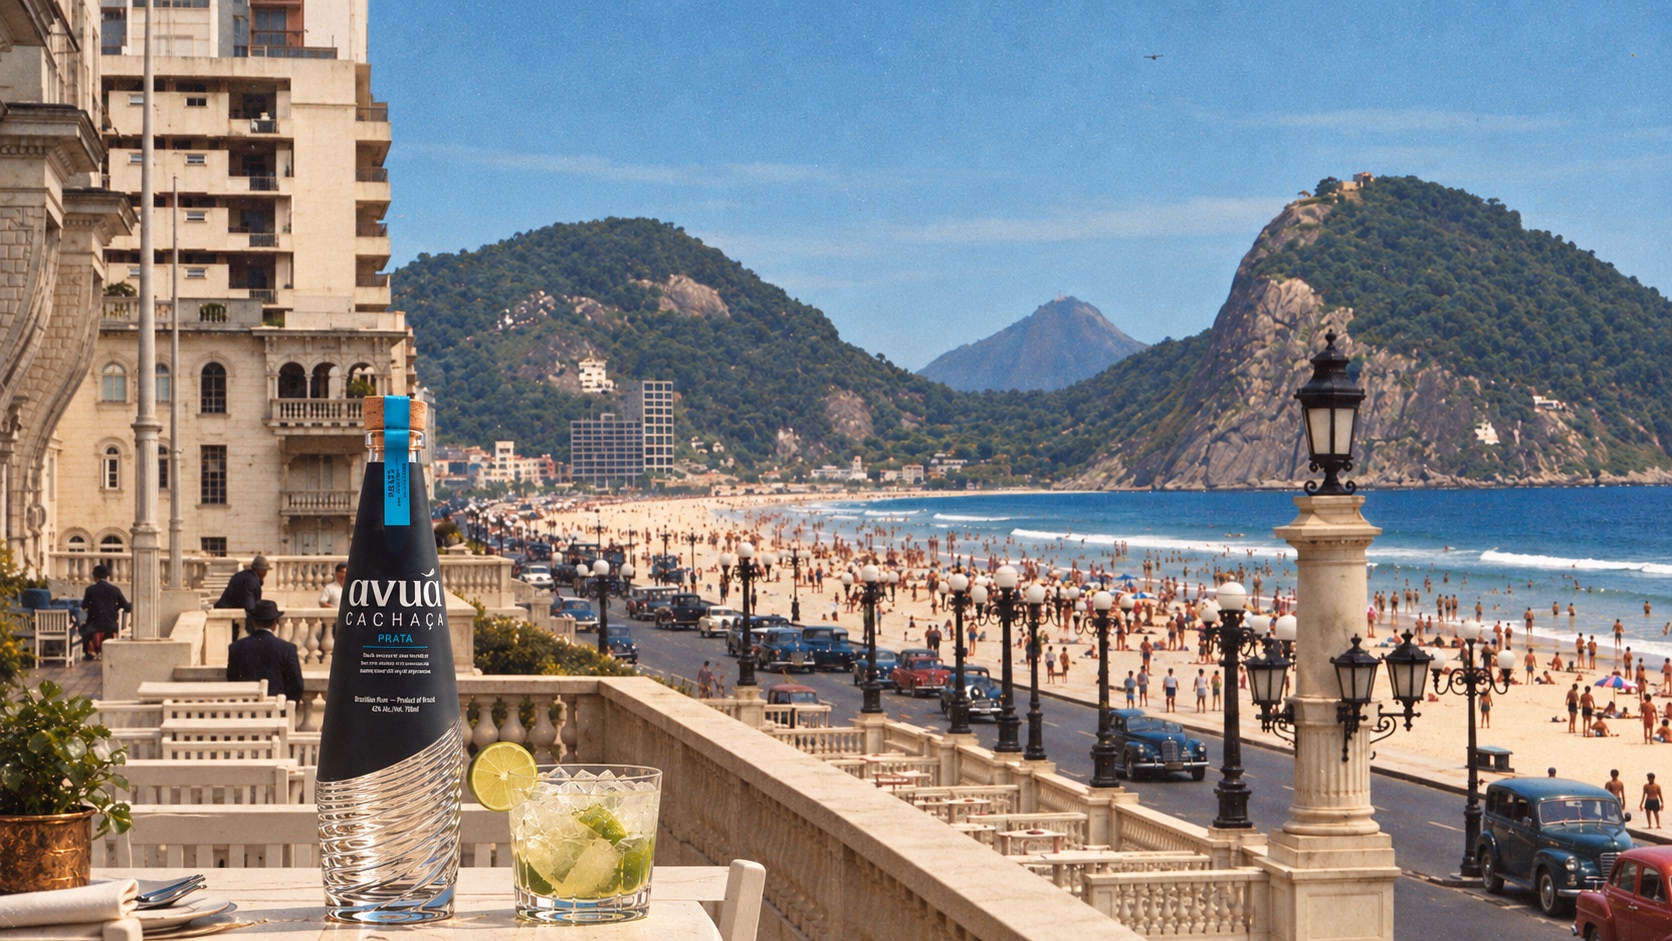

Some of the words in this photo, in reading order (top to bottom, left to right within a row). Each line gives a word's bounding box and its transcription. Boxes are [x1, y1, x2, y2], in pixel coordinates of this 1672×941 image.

[348, 567, 442, 607] avuá
[345, 611, 444, 631] CACHAÇA
[377, 634, 413, 643] PRATA
